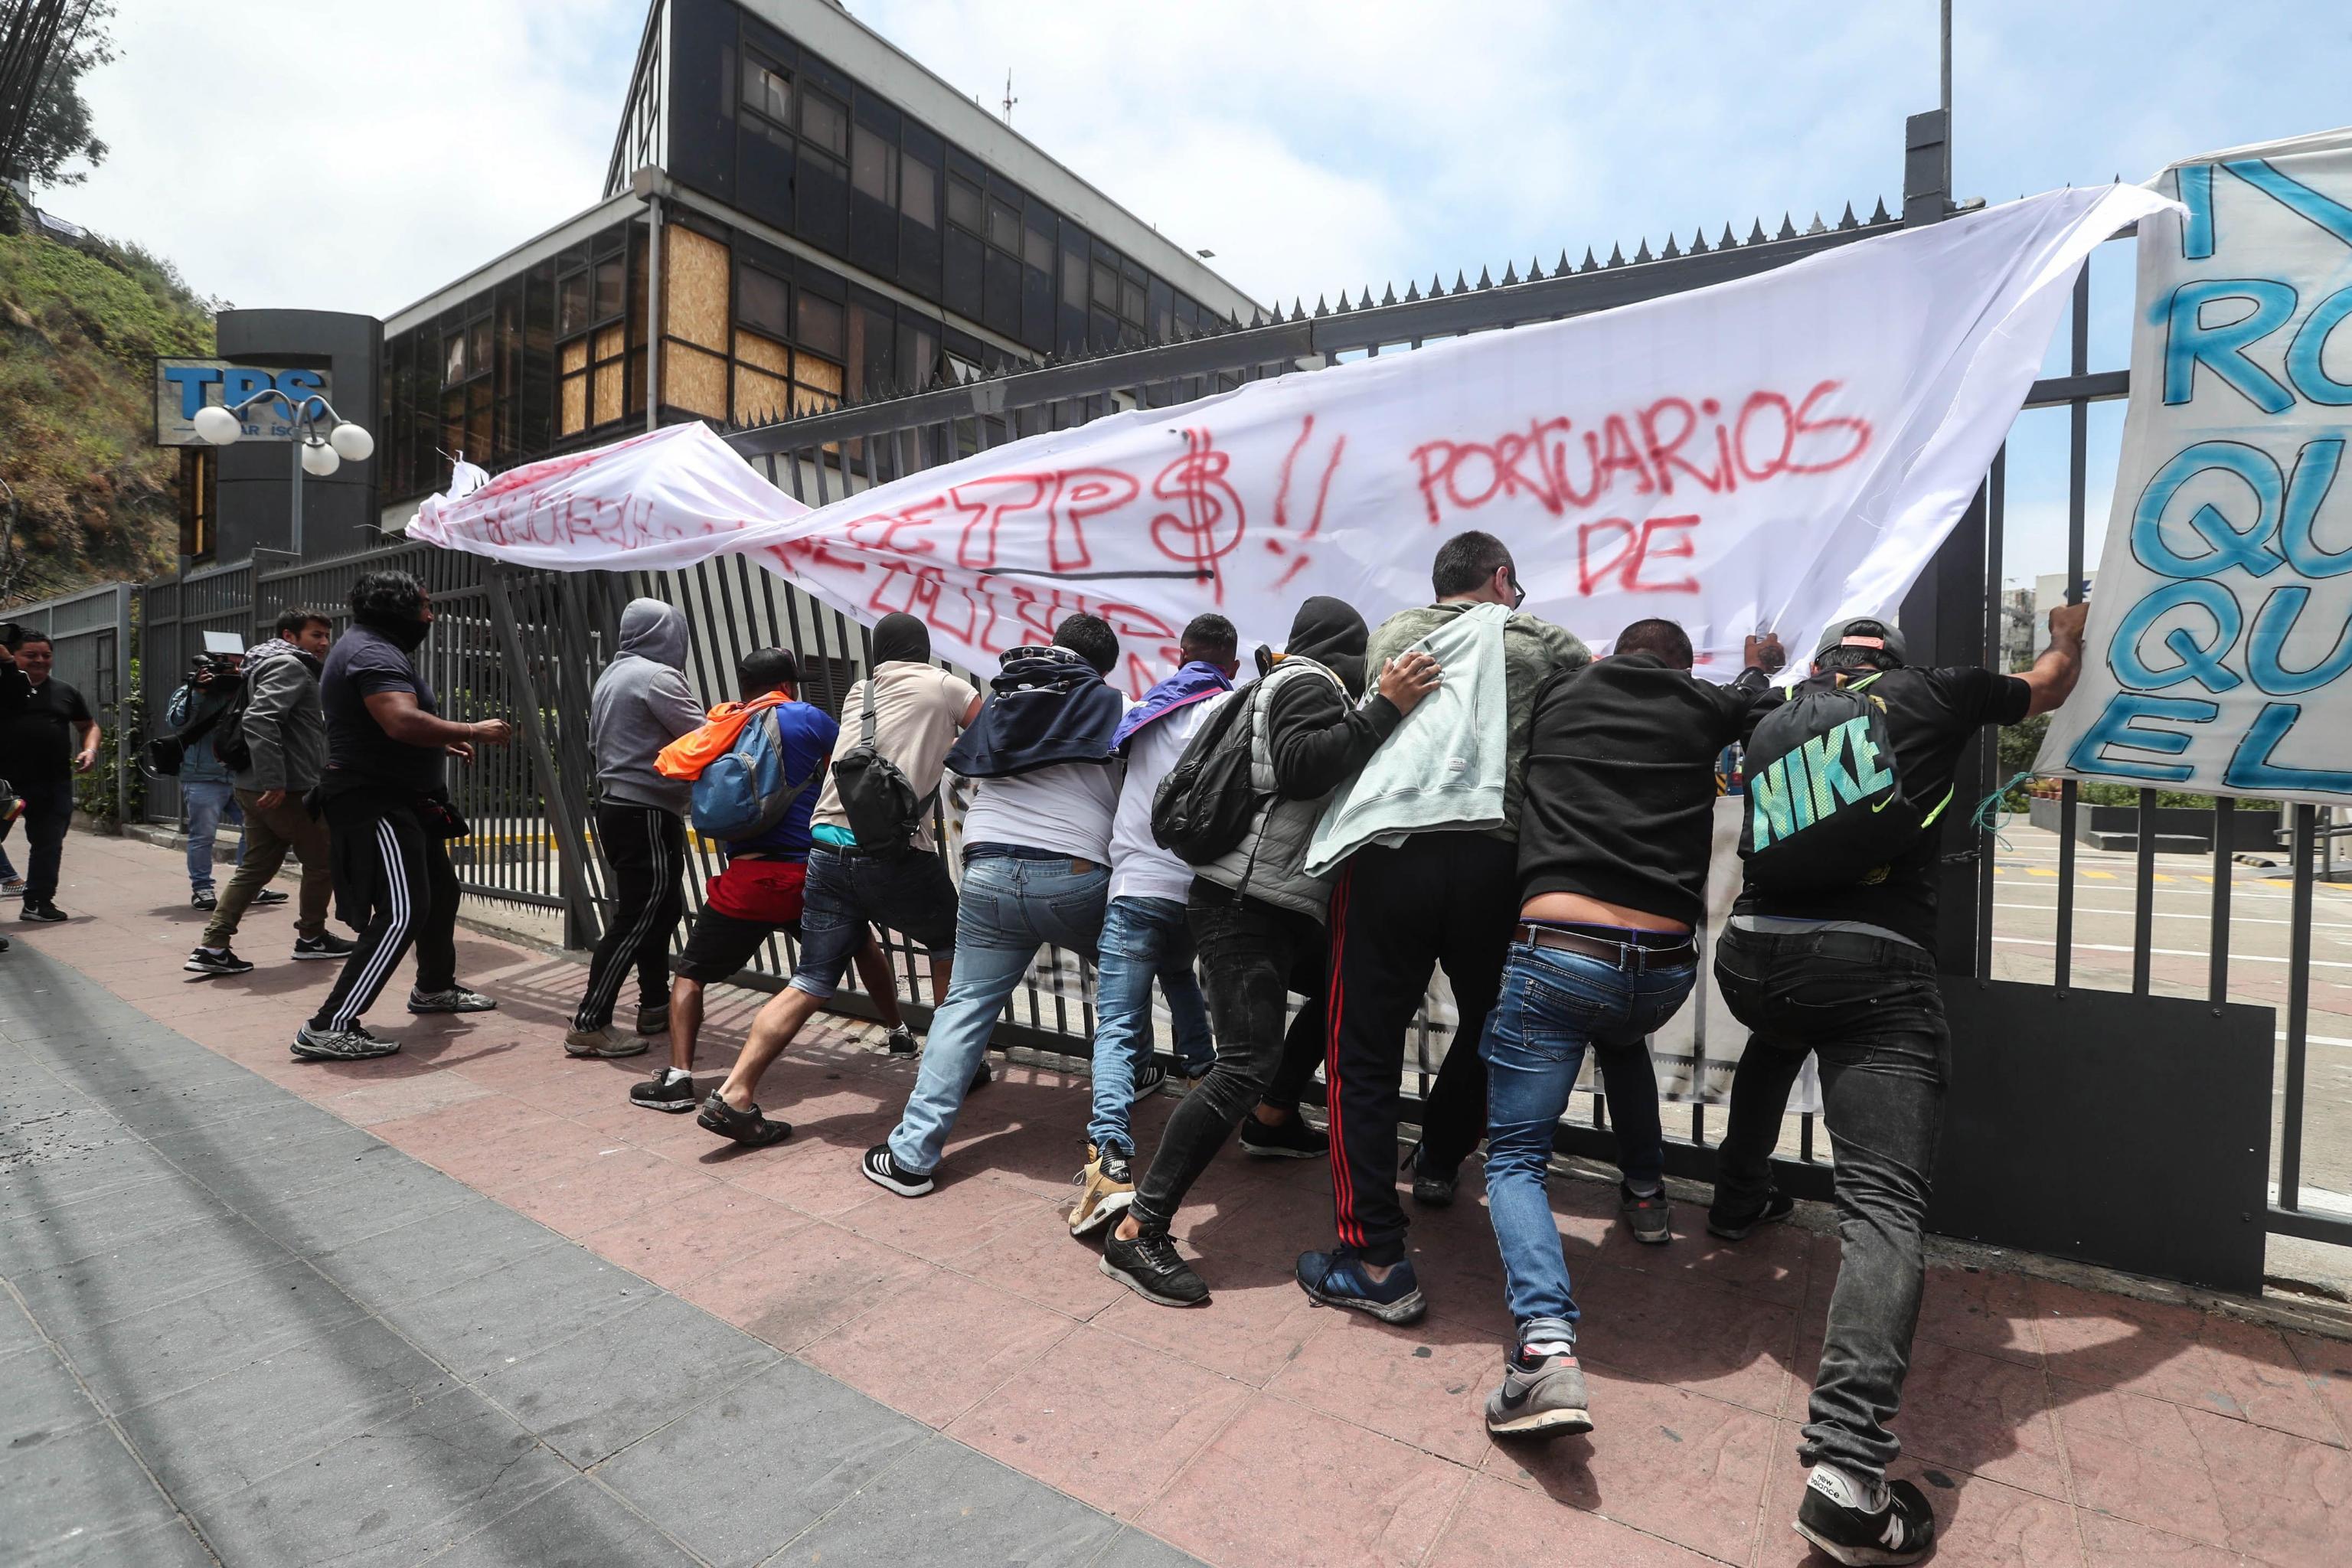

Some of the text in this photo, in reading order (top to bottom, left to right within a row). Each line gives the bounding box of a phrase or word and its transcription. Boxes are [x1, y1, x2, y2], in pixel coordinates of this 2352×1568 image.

[165, 367, 328, 423] TPS
[1577, 513, 1701, 596] DE
[2106, 579, 2352, 697] QU
[1751, 715, 1893, 853] NIKE
[2066, 690, 2352, 795] EL
[1811, 1477, 1840, 1498] balance
[1817, 1473, 1834, 1487] new
